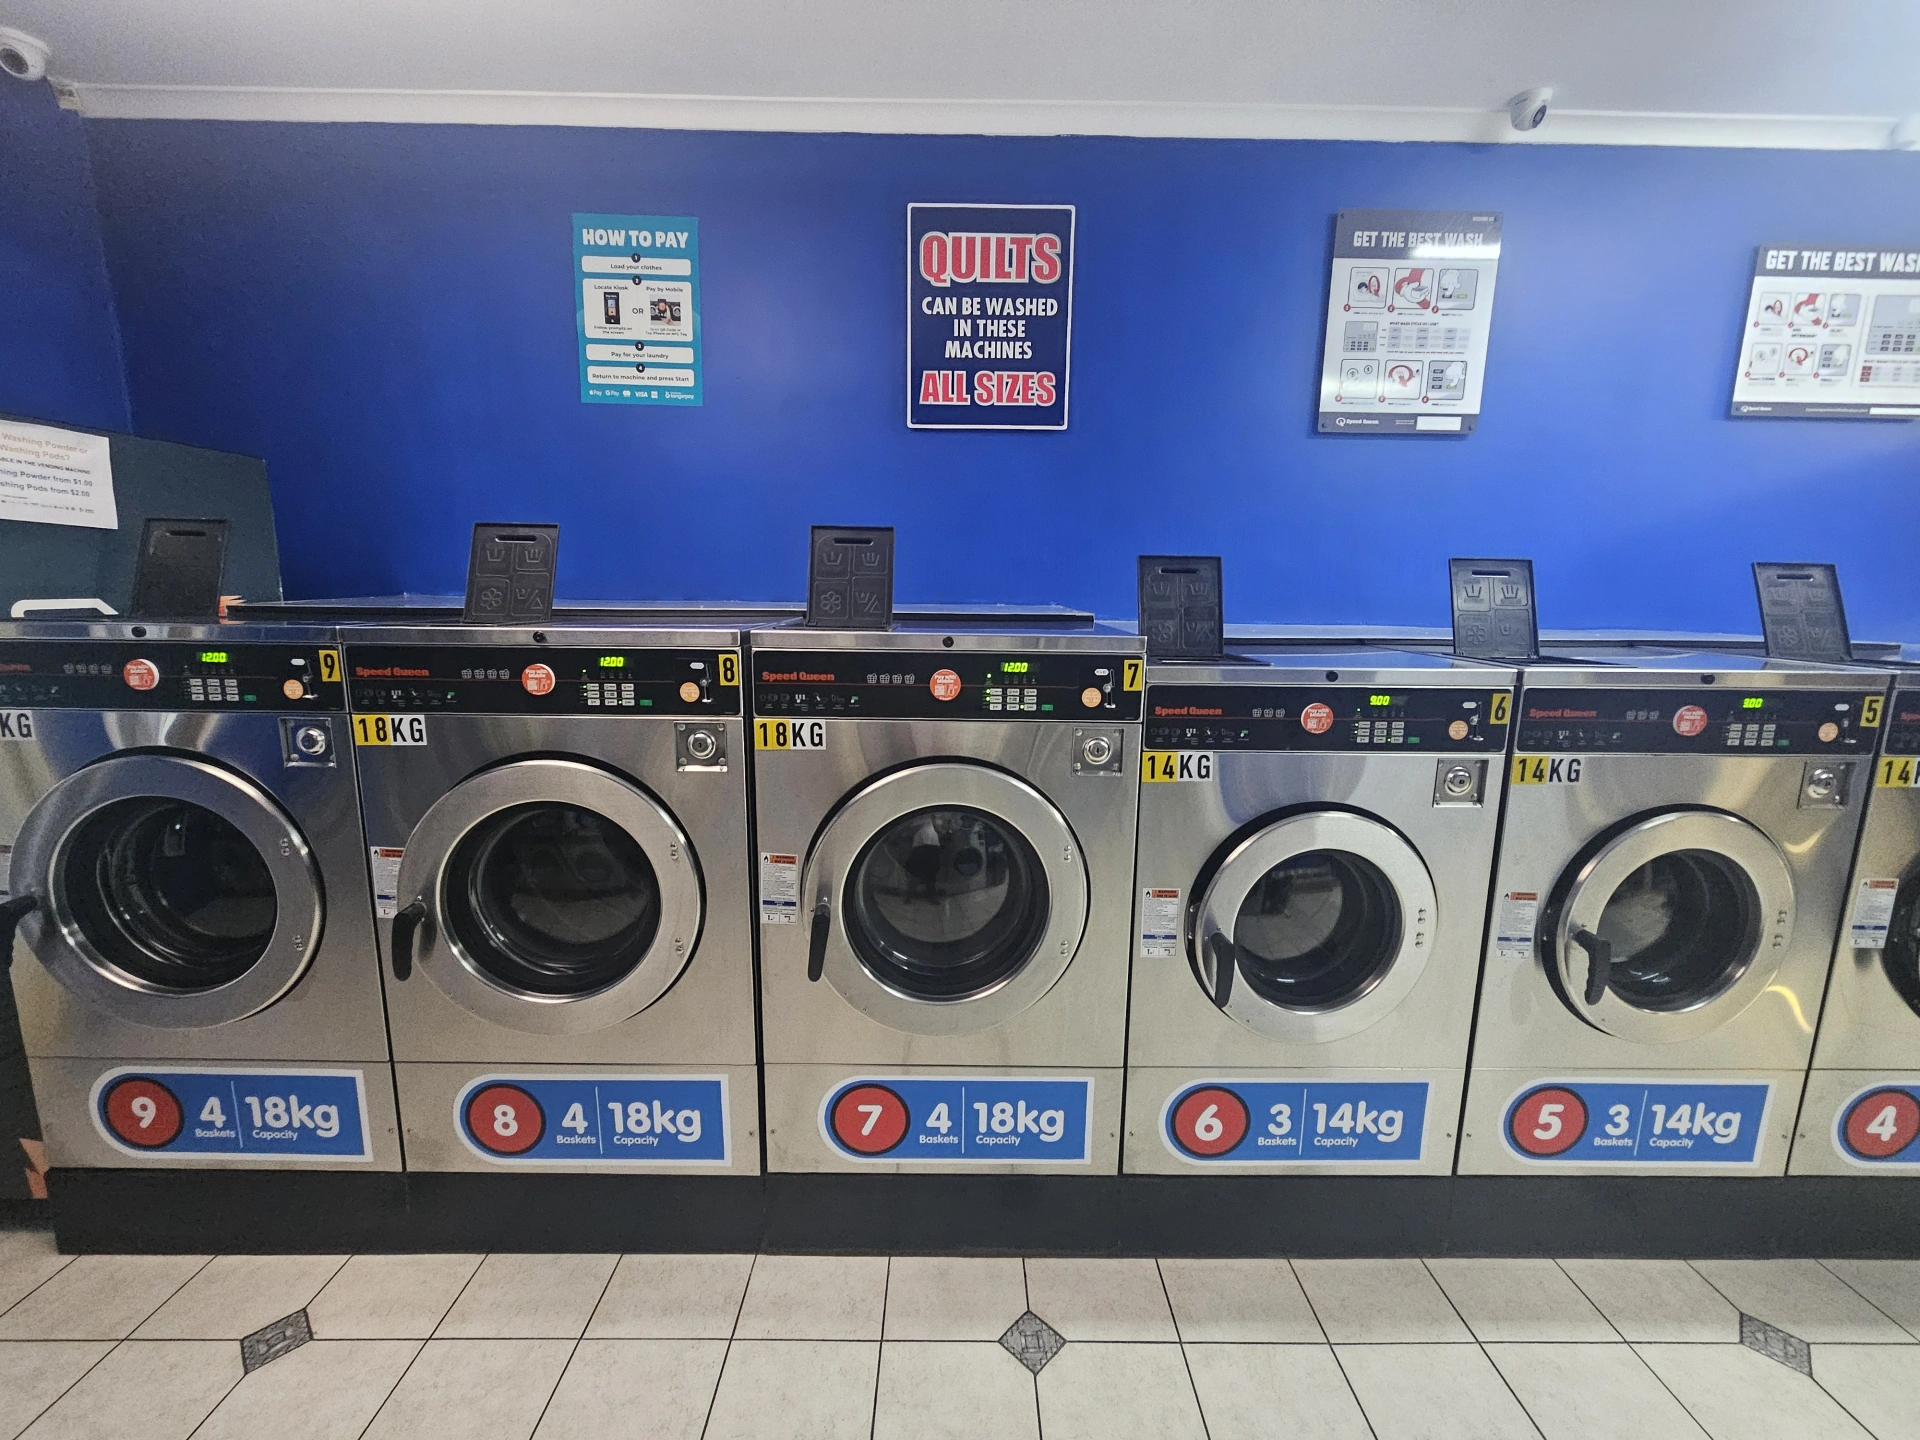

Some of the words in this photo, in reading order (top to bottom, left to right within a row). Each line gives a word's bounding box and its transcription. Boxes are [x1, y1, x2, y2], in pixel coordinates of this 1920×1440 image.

[582, 229, 626, 246] HOW
[629, 230, 652, 247] TO
[655, 231, 689, 248] PAY
[1353, 231, 1379, 247] GET
[1381, 231, 1406, 248] THE
[1408, 231, 1441, 247] BEST
[1444, 232, 1484, 248] WASH
[920, 231, 1061, 287] QUILTS
[1765, 250, 1799, 270] GET
[1800, 250, 1831, 271] THE
[1833, 251, 1877, 272] BEST
[922, 297, 957, 315] CAN
[962, 297, 981, 315] BE
[985, 298, 1058, 316] WASHED
[954, 319, 972, 337] IN
[977, 320, 1026, 338] THESE
[944, 341, 1032, 359] MACHINES
[919, 370, 971, 405] ALL
[974, 370, 1056, 406] SIZES
[0, 444, 40, 458] Washing
[42, 451, 70, 461] Pods?
[1, 433, 42, 448] Washing
[45, 441, 77, 453] Powder
[20, 471, 51, 481] Powder
[53, 475, 71, 484] from
[73, 479, 93, 487] $1.00
[38, 462, 64, 471] VENDING
[65, 467, 91, 475] MACHINE
[27, 483, 48, 492] Pods
[71, 489, 90, 497] $2.00
[201, 652, 227, 663] 12.00
[323, 653, 335, 679] 9
[600, 656, 624, 667] 12.00
[1003, 662, 1029, 673] 12.00
[356, 667, 392, 677] Speed
[393, 667, 430, 677] Queen
[722, 657, 735, 682] 8
[762, 671, 797, 682] Speed
[799, 671, 835, 681] Queen
[1127, 663, 1139, 688] 7
[1155, 706, 1188, 716] Speed
[1189, 706, 1223, 716] Queen
[1370, 695, 1390, 706] 9.00
[1495, 696, 1507, 721] 6
[1866, 699, 1879, 723] 5
[1529, 708, 1562, 719] Speed
[1563, 709, 1597, 718] Queen
[358, 717, 425, 742] 18KG
[759, 722, 824, 747] 18KG
[1147, 754, 1211, 779] 14KG
[1518, 758, 1581, 783] 14KG
[131, 1097, 157, 1129] 9
[200, 1096, 226, 1128] 4
[245, 1095, 340, 1138] 18kg
[493, 1104, 519, 1136] 8
[561, 1103, 588, 1134] 4
[608, 1100, 701, 1142] 18kg
[857, 1105, 883, 1136] 7
[925, 1102, 952, 1134] 4
[973, 1100, 1065, 1142] 18kg
[1194, 1104, 1223, 1141] 6
[1267, 1104, 1292, 1135] 3
[1313, 1101, 1404, 1142] 14kg
[1533, 1104, 1565, 1140] 5
[1604, 1104, 1630, 1136] 3
[195, 1128, 236, 1138] Baskets
[1651, 1102, 1741, 1144] 14kg
[1866, 1105, 1897, 1142] 4
[253, 1129, 298, 1140] Capacity
[556, 1135, 597, 1144] Baskets
[613, 1136, 659, 1147] Capacity
[919, 1135, 959, 1144] Baskets
[976, 1135, 1020, 1146] Capacity
[1257, 1137, 1297, 1146] Baskets
[1314, 1137, 1359, 1147] Capacity
[1594, 1137, 1633, 1147] Baskets
[1649, 1137, 1694, 1149] Capacity
